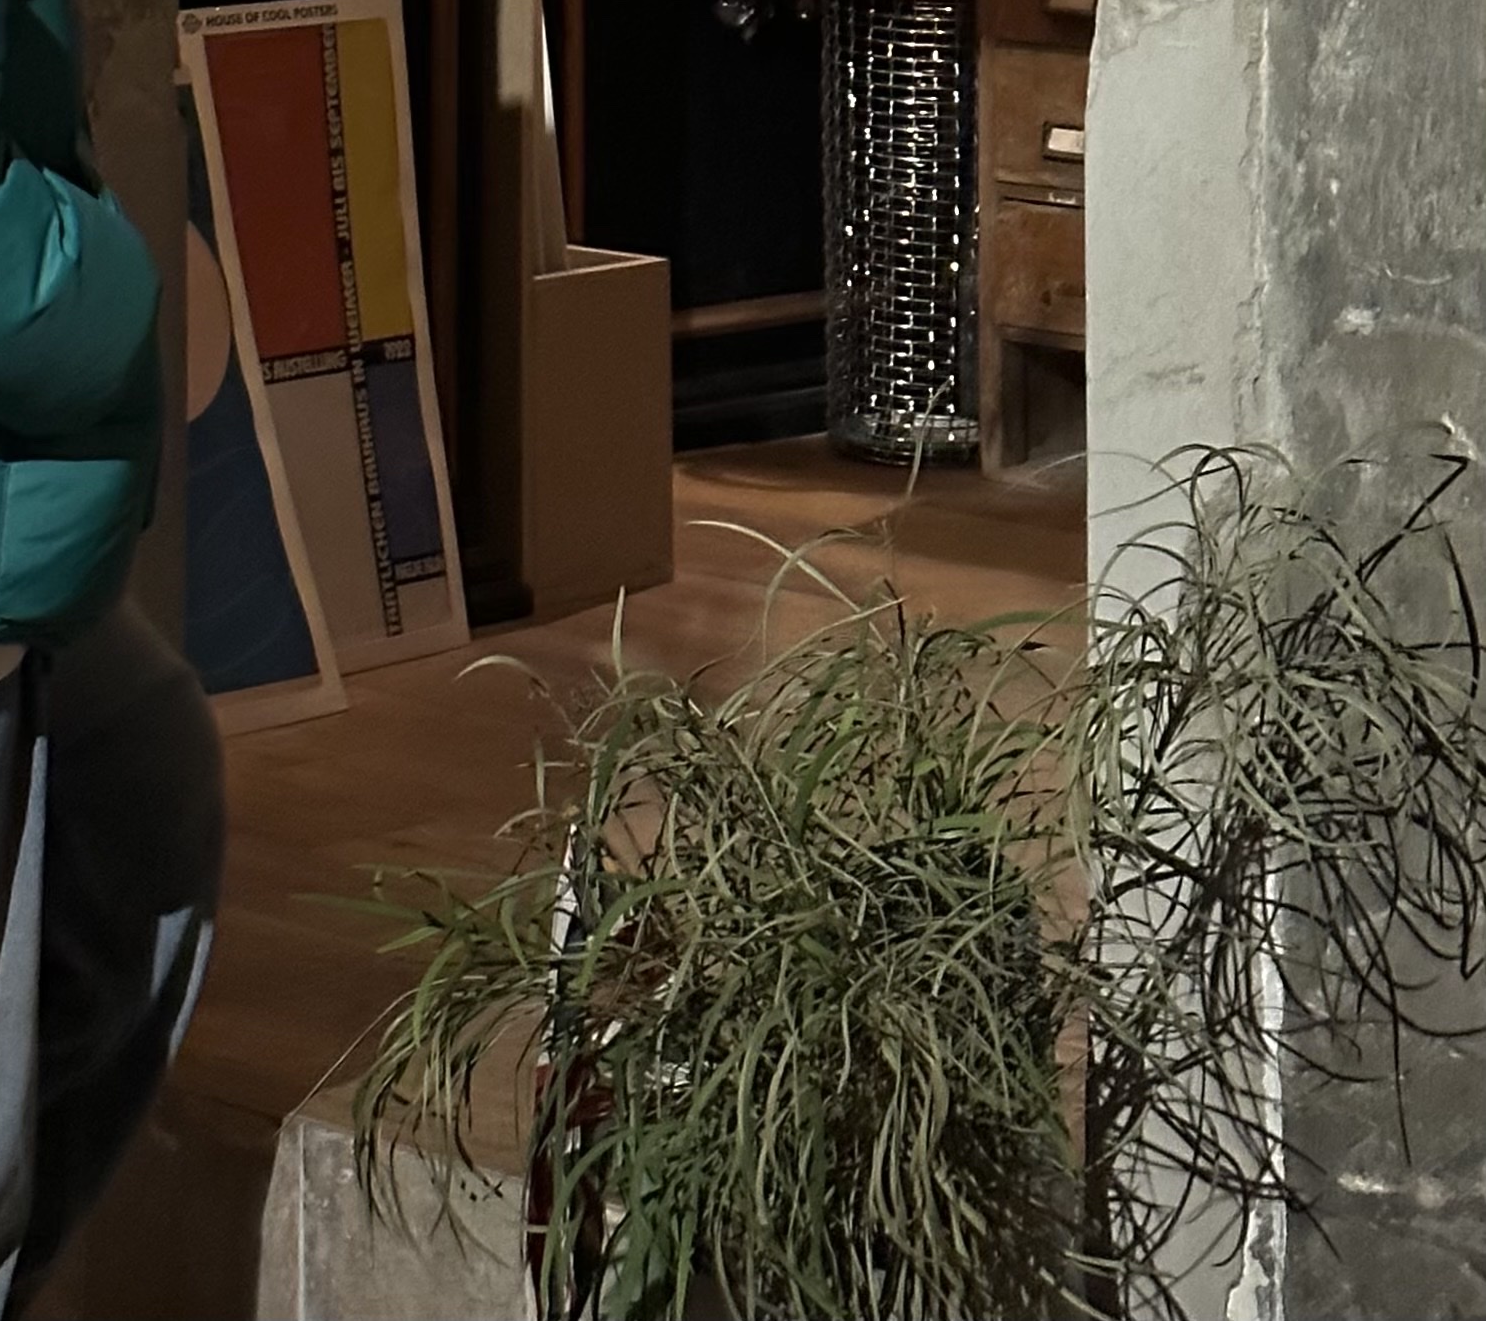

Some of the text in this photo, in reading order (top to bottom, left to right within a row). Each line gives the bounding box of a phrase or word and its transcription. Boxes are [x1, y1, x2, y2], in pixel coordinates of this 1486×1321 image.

[206, 13, 244, 27] HOUSE
[245, 11, 260, 24] OF
[263, 8, 292, 23] COOL
[293, 3, 339, 19] POSTERS
[322, 22, 344, 150] SEPTEMBER
[331, 155, 346, 192] BIS
[334, 196, 350, 241] JULI
[351, 358, 366, 384] IN
[356, 388, 382, 495] BAUHAUS
